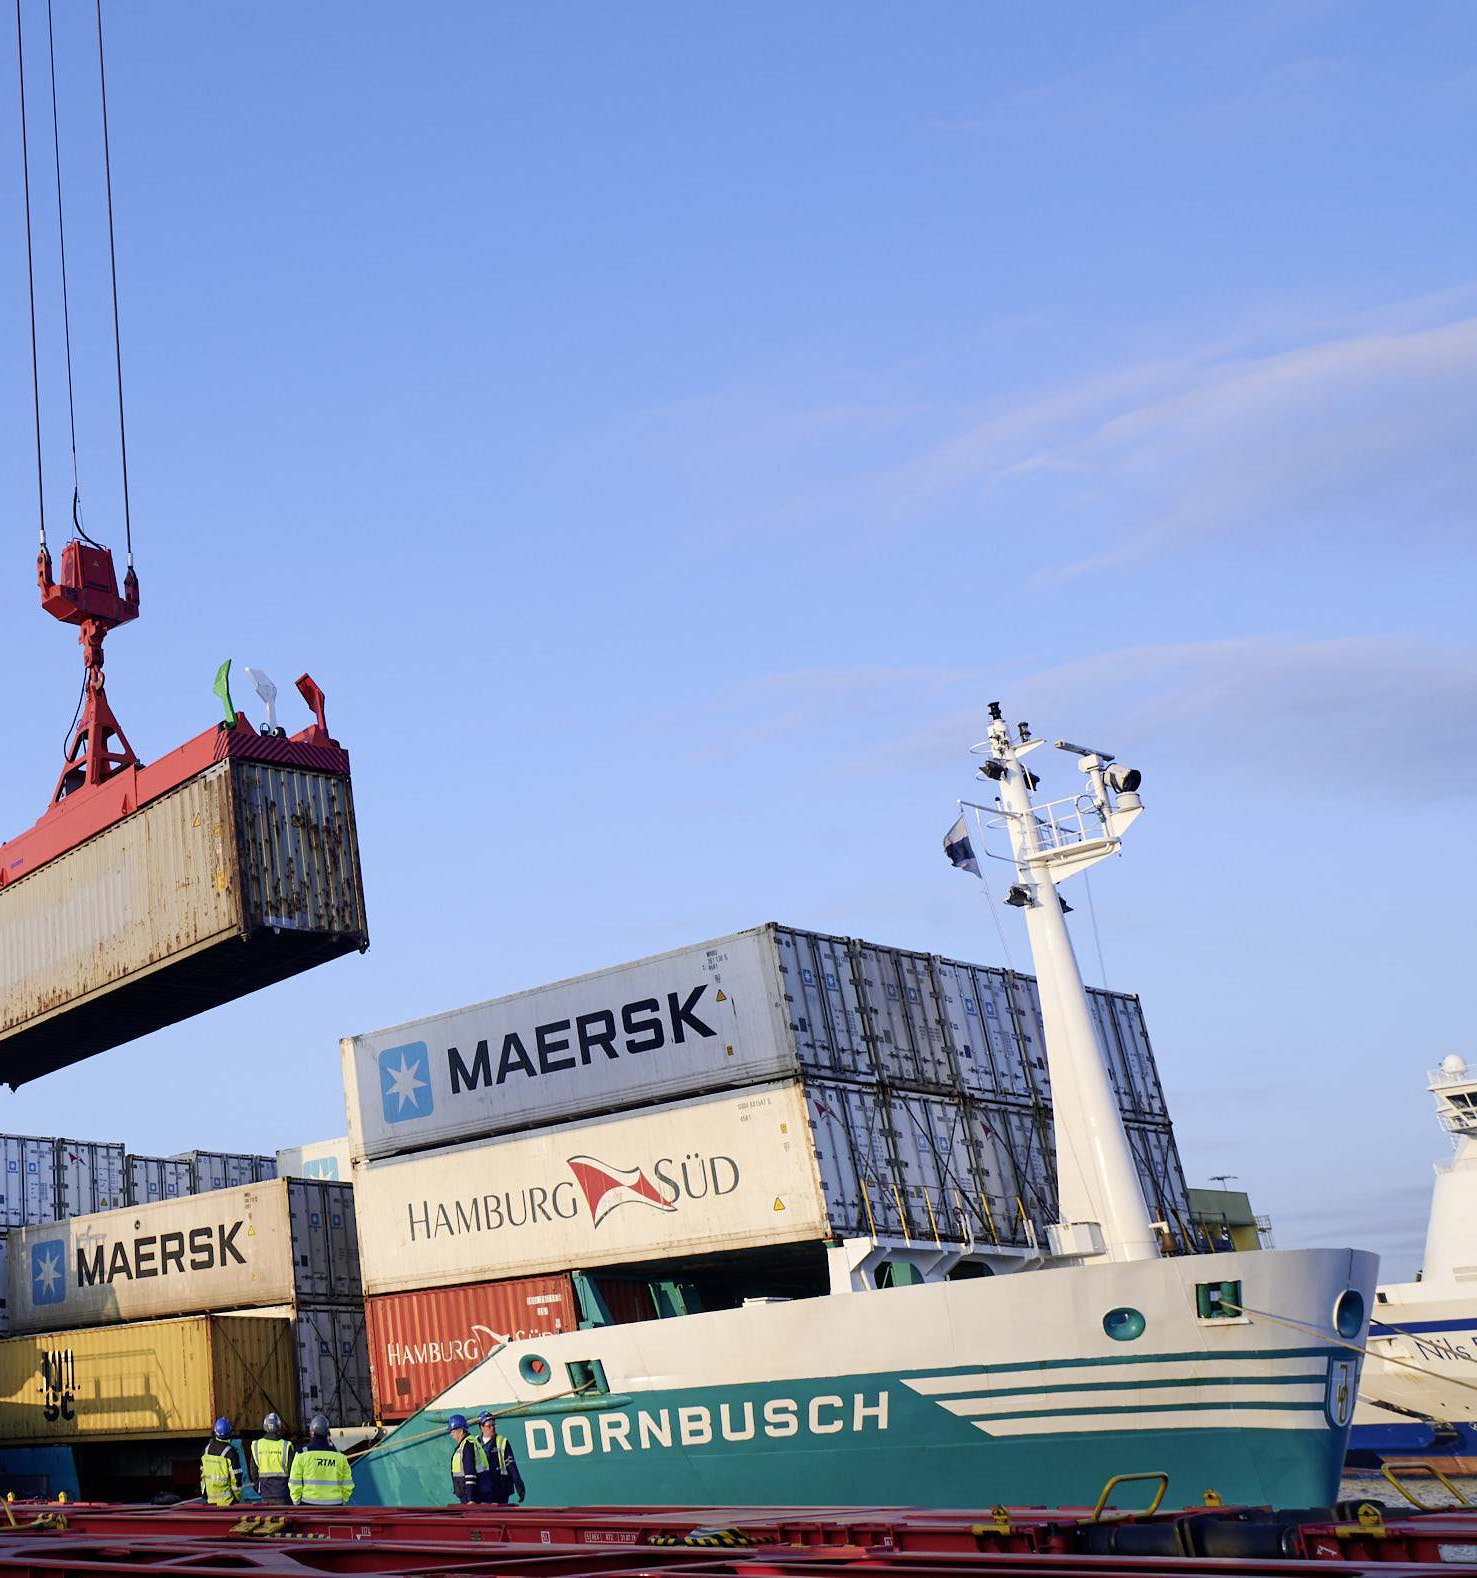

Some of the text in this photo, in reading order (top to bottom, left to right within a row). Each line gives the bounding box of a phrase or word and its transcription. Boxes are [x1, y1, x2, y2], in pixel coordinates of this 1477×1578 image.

[447, 984, 717, 1094] MAERSK
[407, 1153, 740, 1242] HAMBURG SÜD
[77, 1221, 247, 1287] MAERSK
[387, 1339, 479, 1367] HAMBURG
[1414, 1337, 1472, 1361] Nils
[525, 1391, 888, 1459] DORNBUSCH
